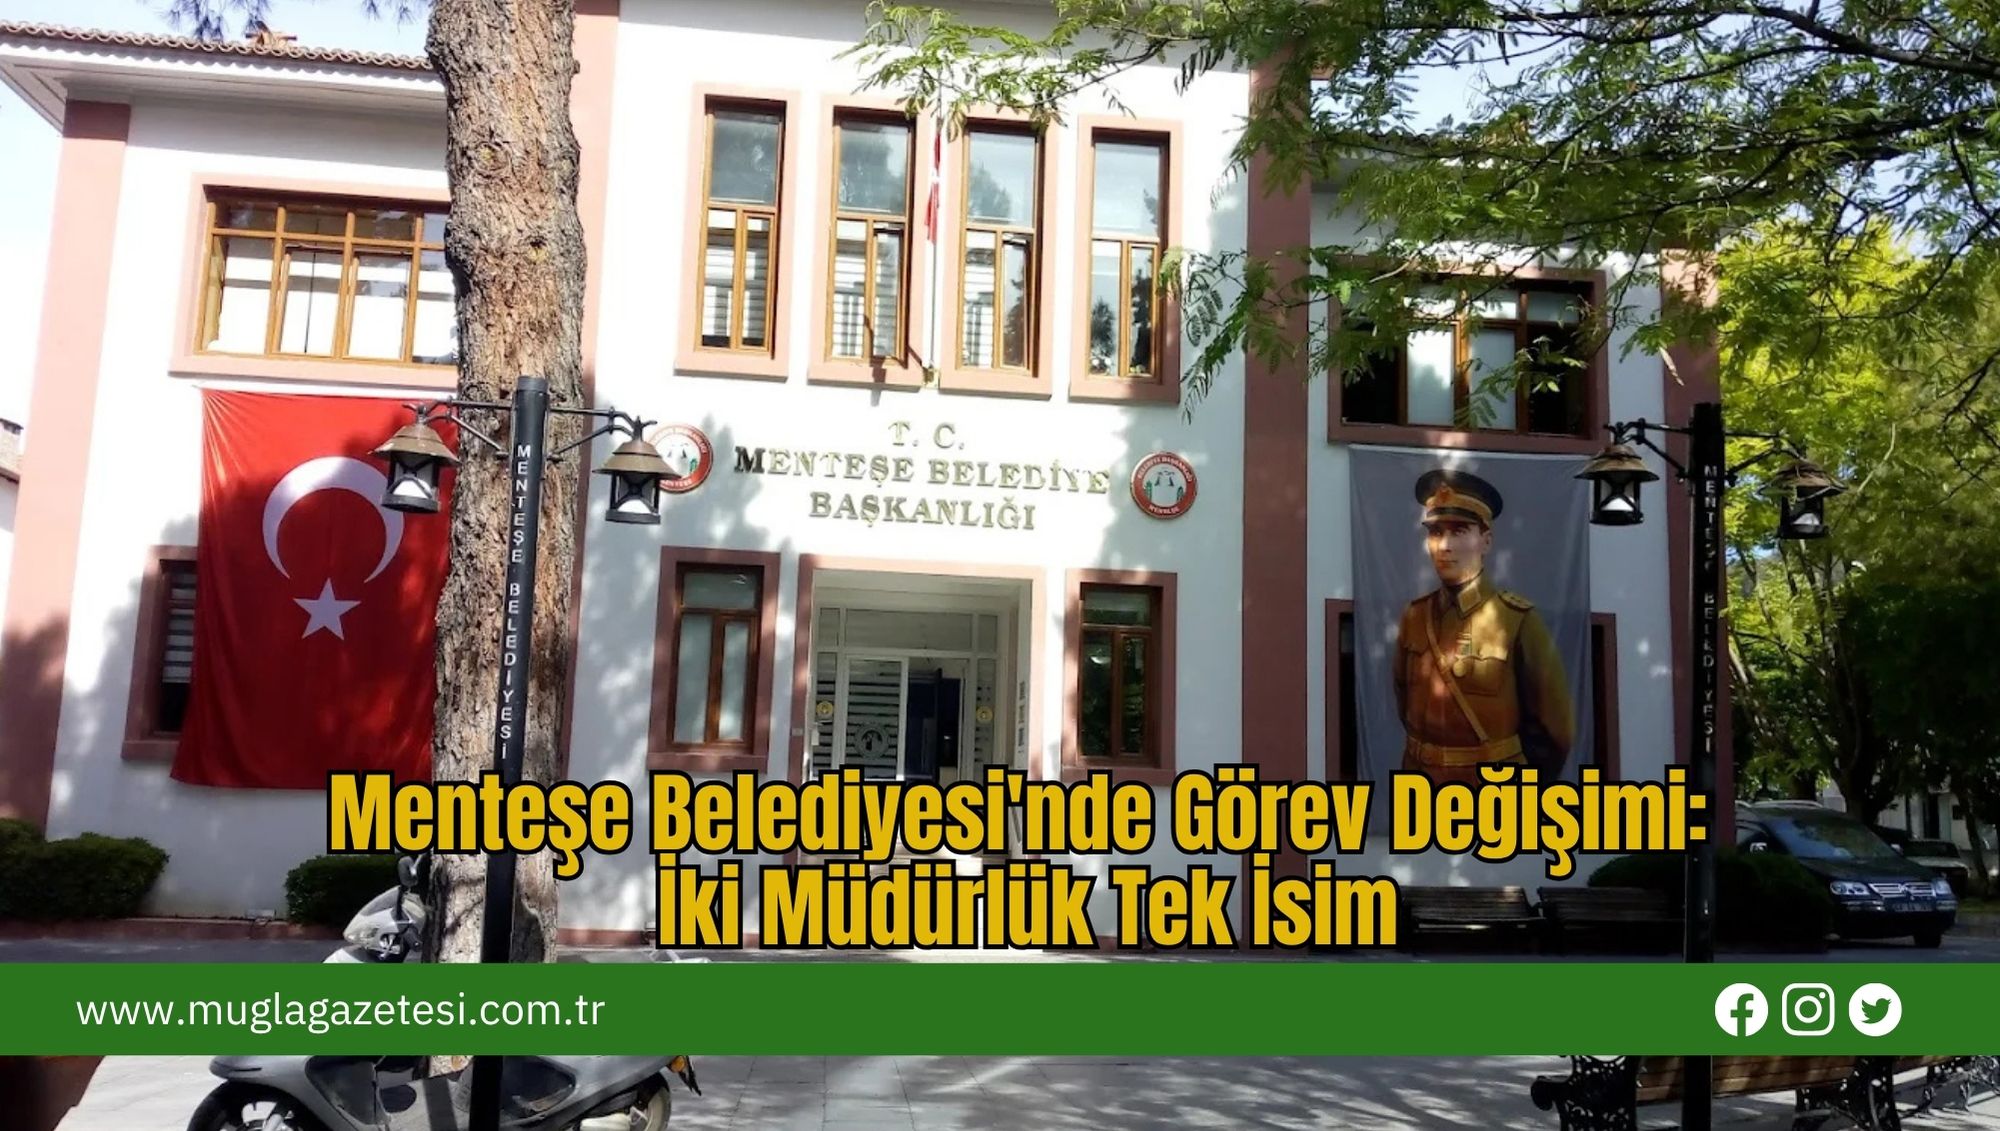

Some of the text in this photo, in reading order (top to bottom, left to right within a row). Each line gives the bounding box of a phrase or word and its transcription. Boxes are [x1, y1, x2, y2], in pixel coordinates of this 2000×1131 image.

[888, 420, 965, 450] T. C.
[734, 445, 1111, 494] MENTEŞE BELEDİYE
[511, 444, 531, 563] MENTEŞE
[808, 491, 1036, 531] BAŞKANLIĞI
